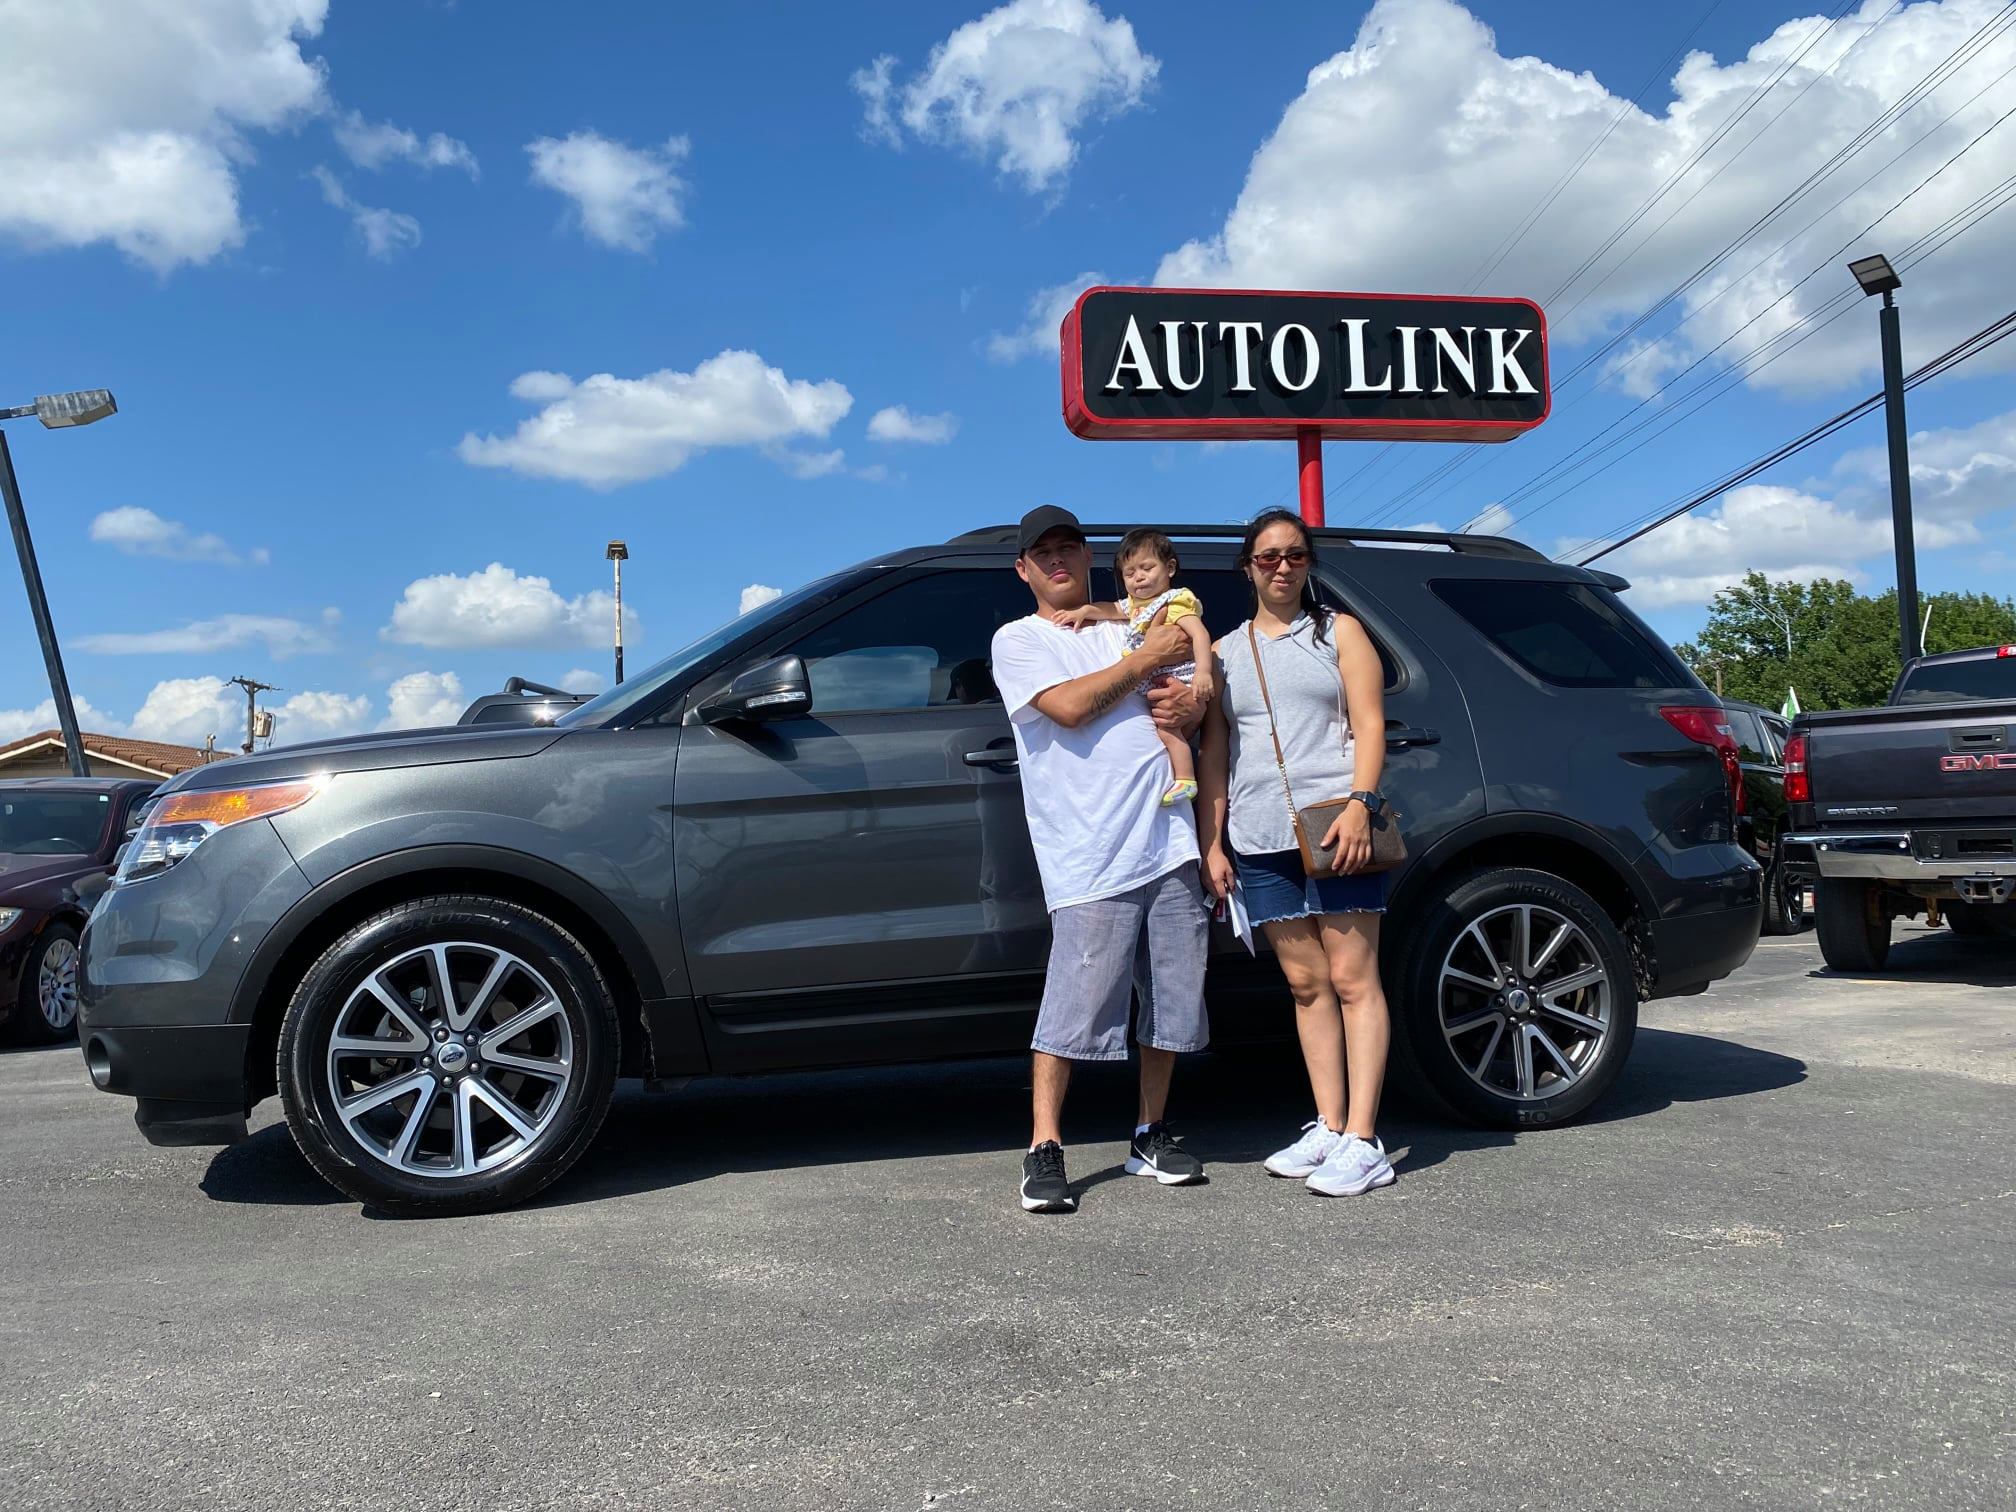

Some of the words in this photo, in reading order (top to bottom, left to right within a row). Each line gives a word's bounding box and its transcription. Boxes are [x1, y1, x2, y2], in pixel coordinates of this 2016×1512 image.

[1105, 314, 1320, 391] AUTO
[1341, 318, 1539, 394] LINK
[1941, 753, 2016, 771] GMC
